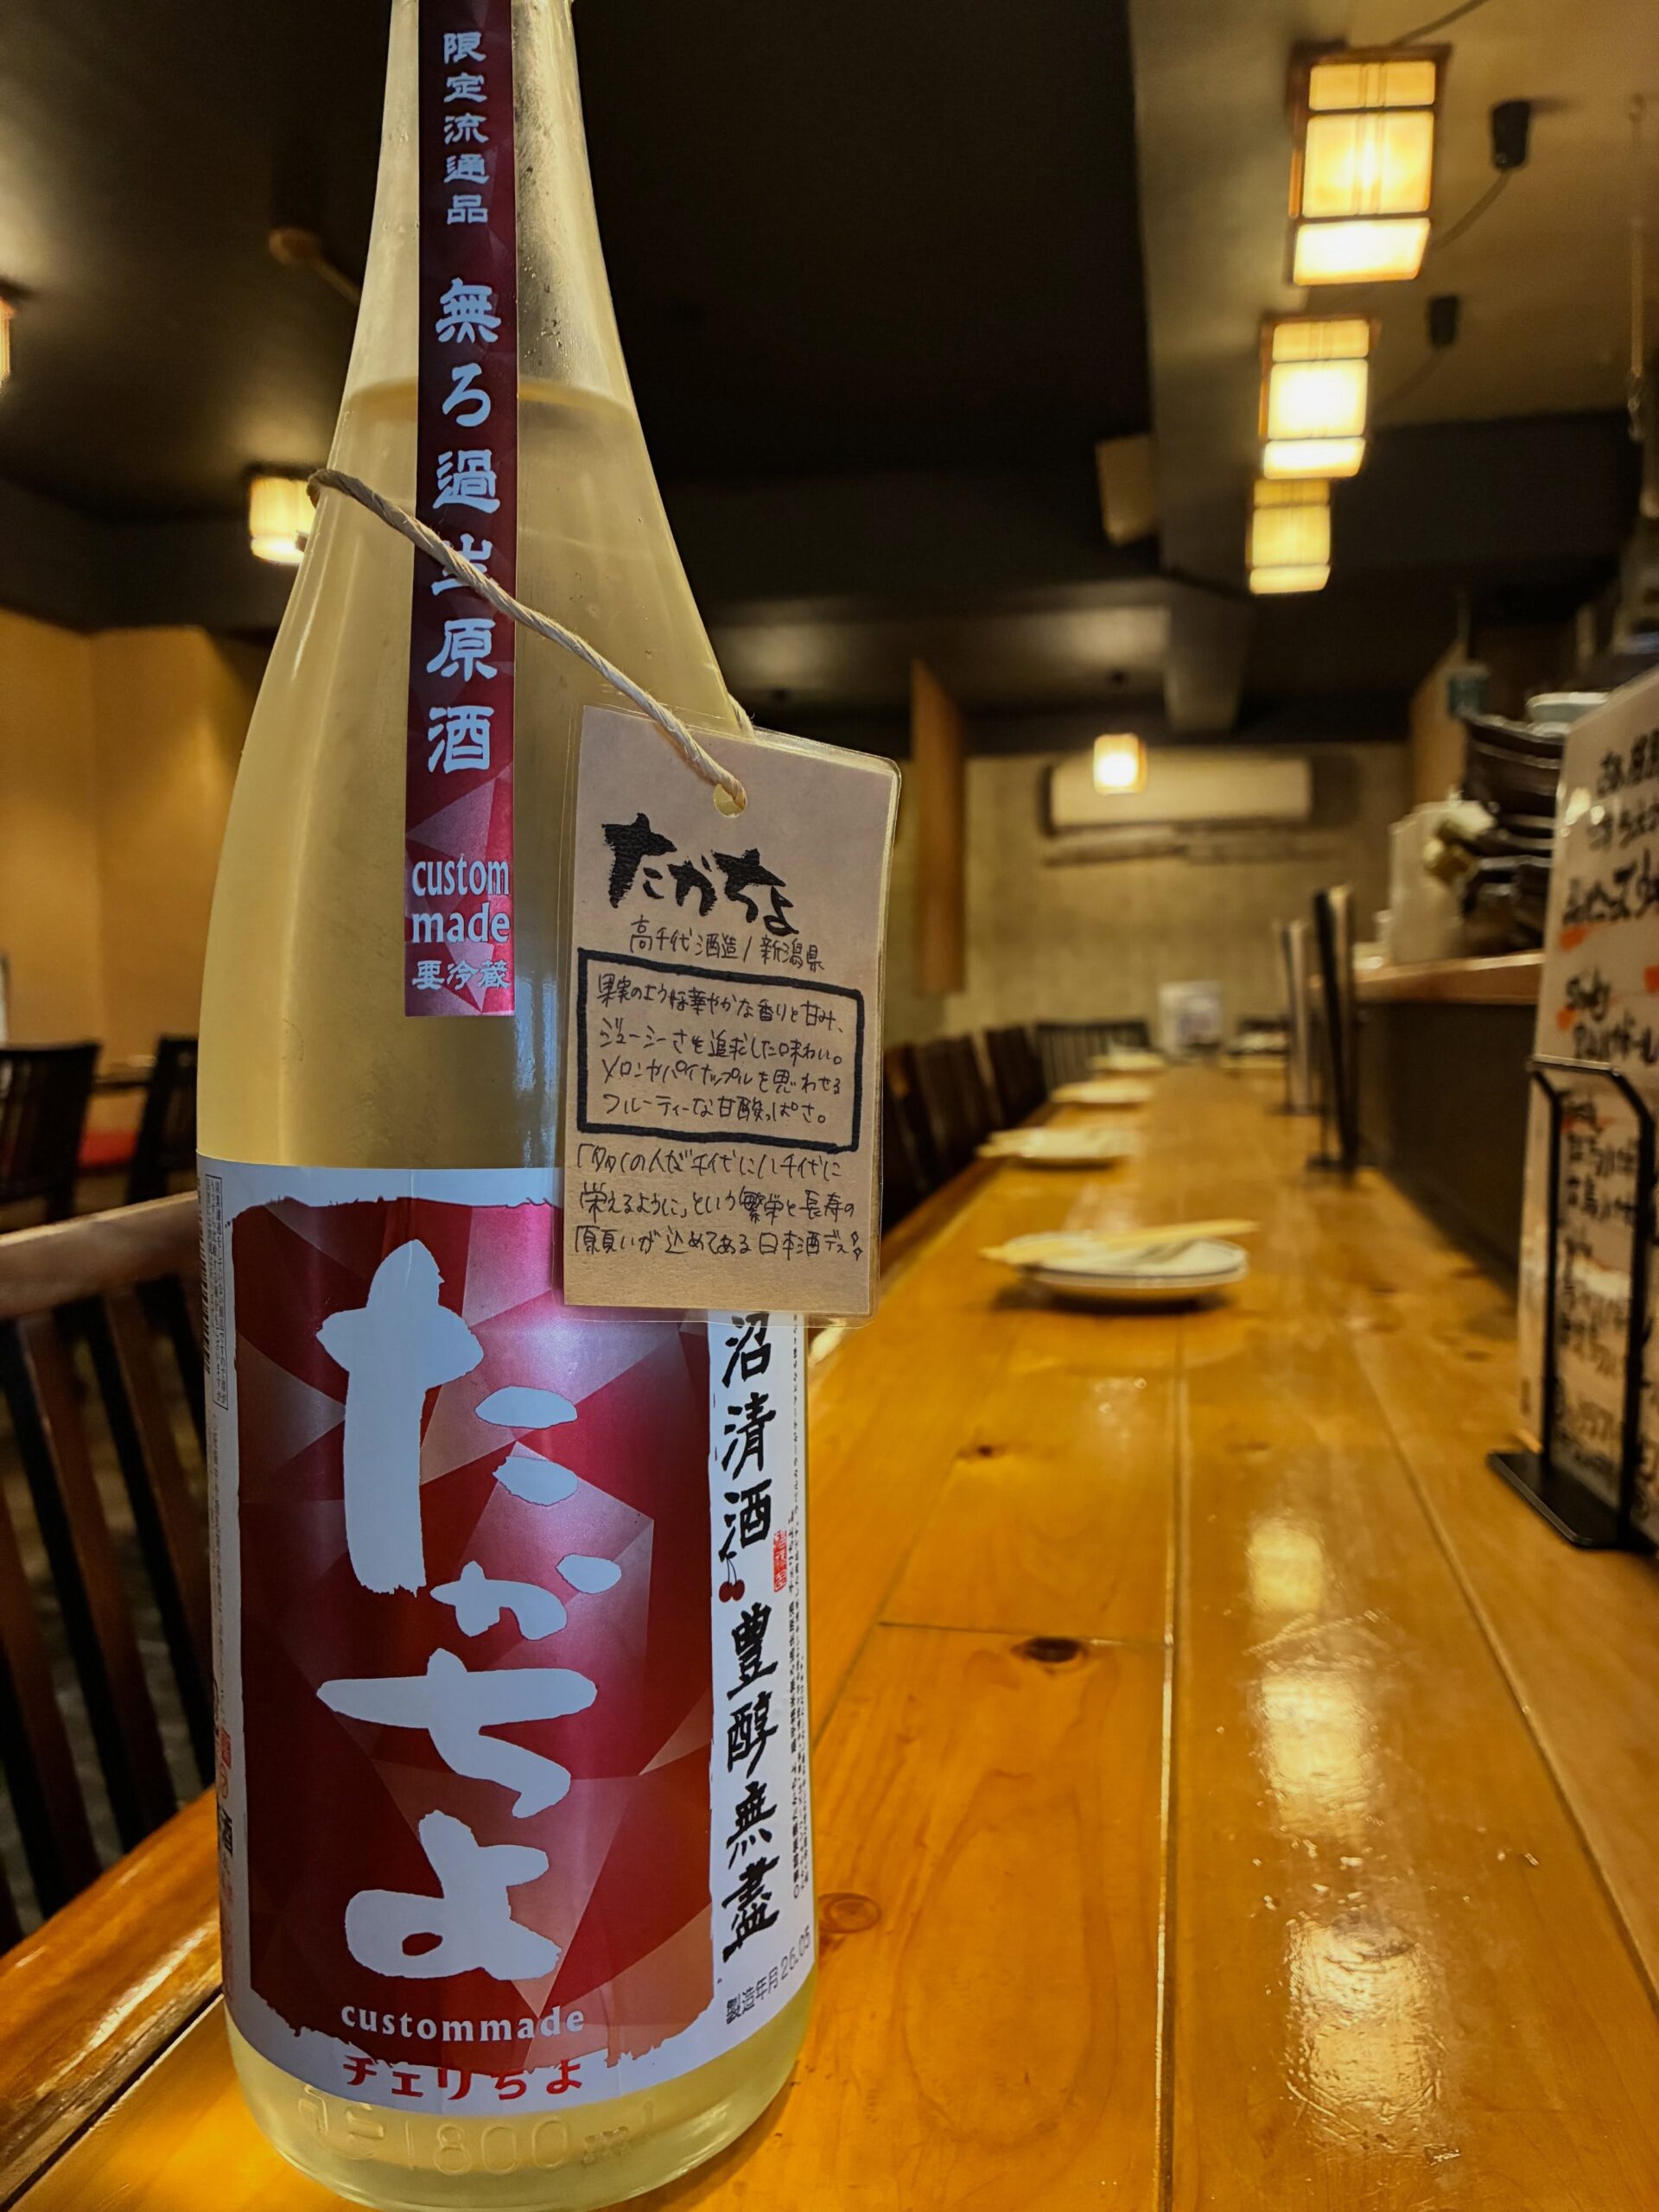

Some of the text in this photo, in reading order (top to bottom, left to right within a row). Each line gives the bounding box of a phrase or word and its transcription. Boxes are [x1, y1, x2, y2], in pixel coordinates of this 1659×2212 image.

[443, 31, 490, 226] 限定流通品
[426, 276, 501, 774] 無ろ過生原酒
[411, 853, 510, 897] custom
[601, 812, 798, 936] たかちよ
[411, 901, 511, 944] made
[411, 959, 511, 990] 要冷蔵
[602, 1055, 841, 1094] メロンやパイナップルを思わせる
[316, 1239, 623, 1980] たかちよ
[341, 2005, 585, 2042] custommade
